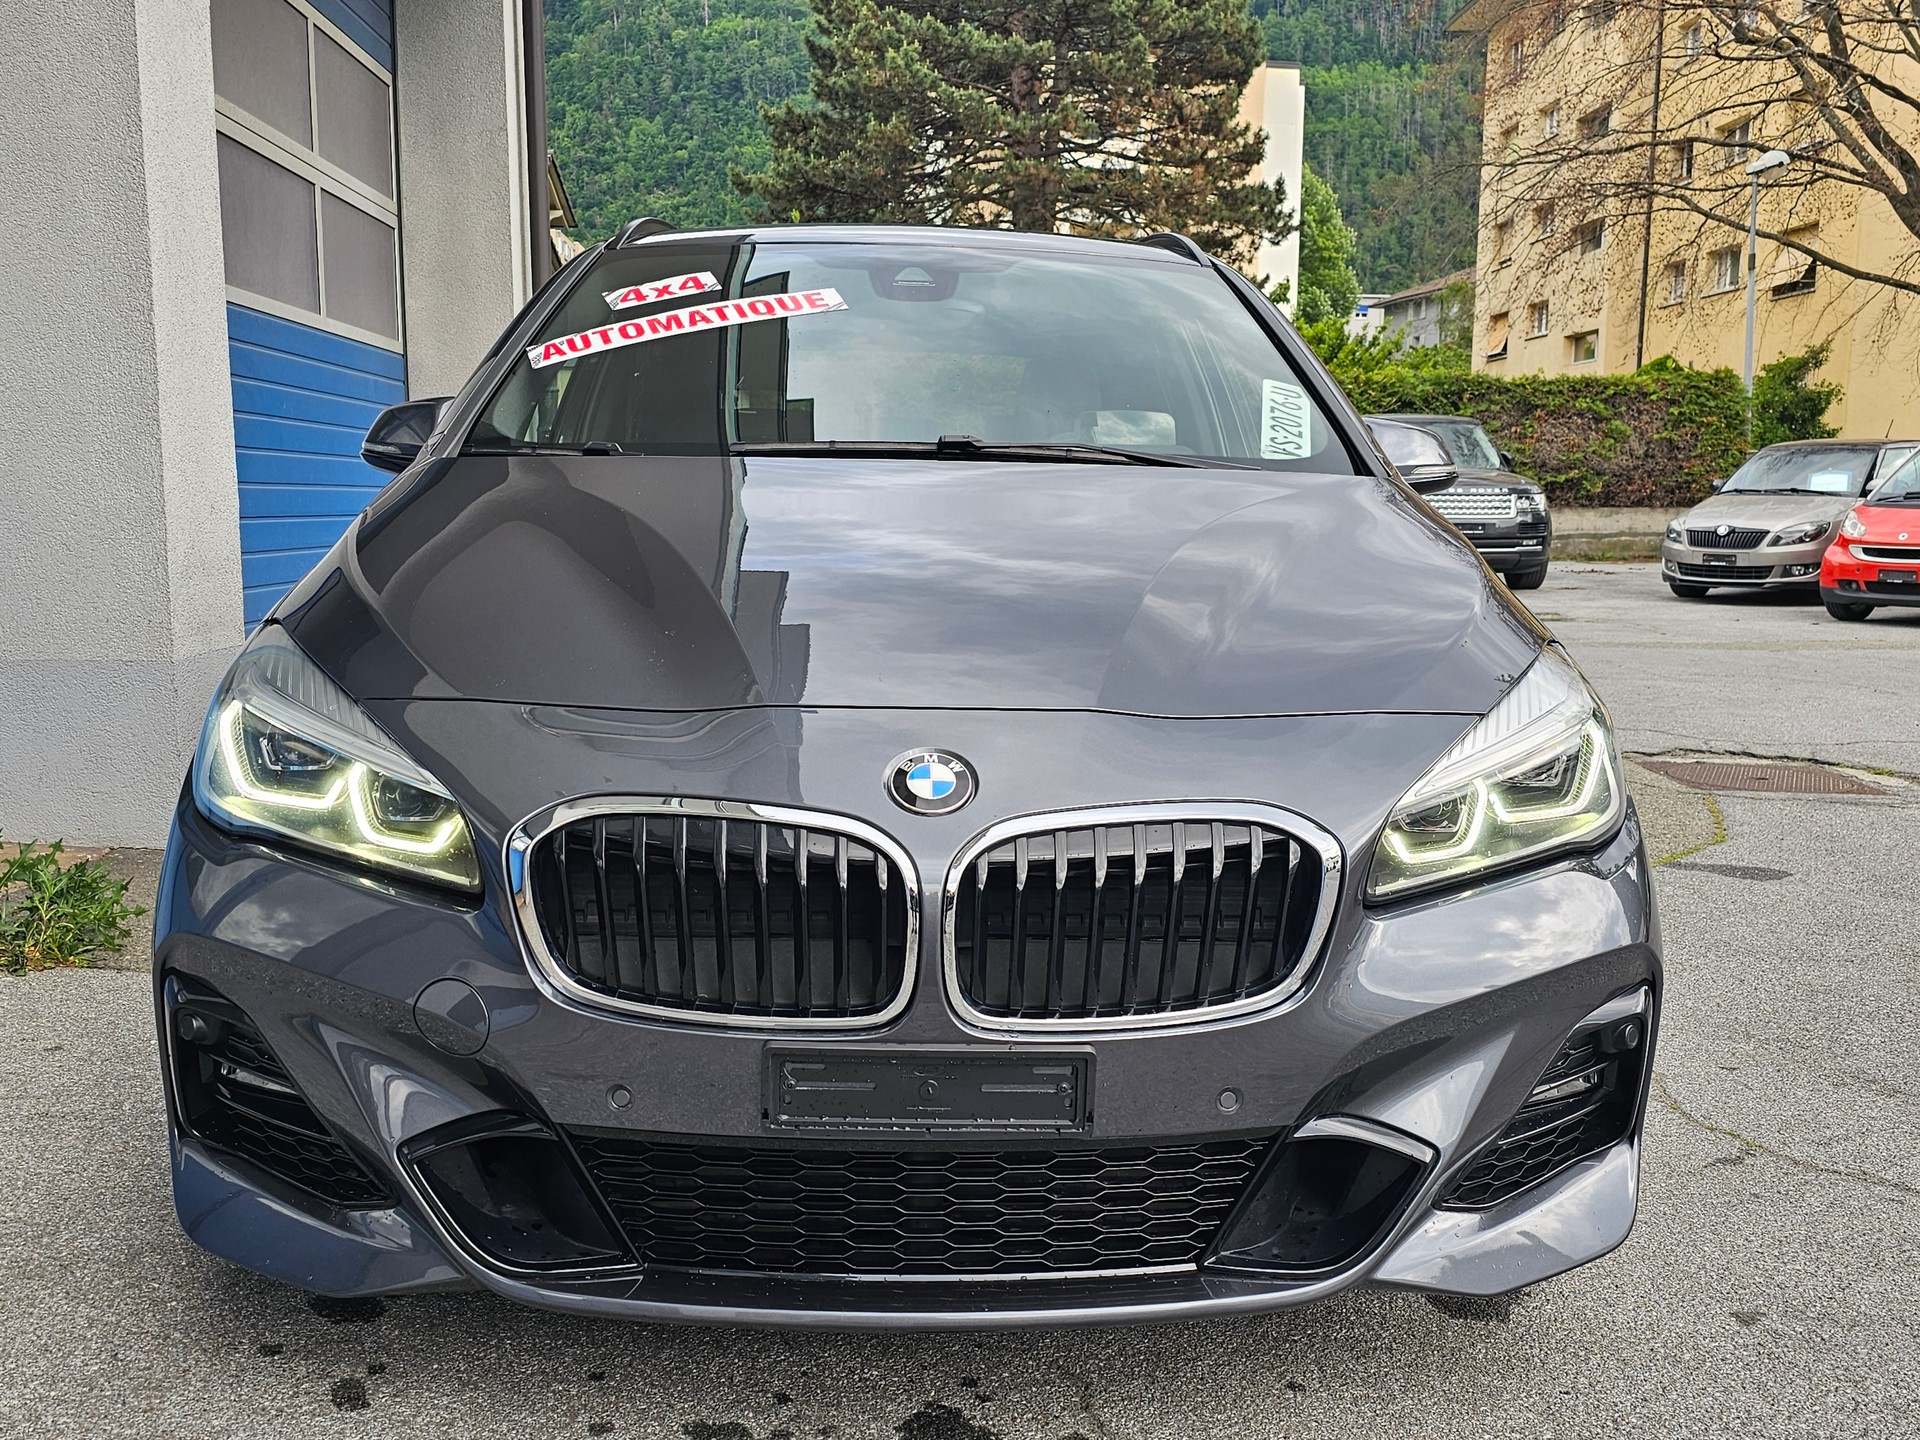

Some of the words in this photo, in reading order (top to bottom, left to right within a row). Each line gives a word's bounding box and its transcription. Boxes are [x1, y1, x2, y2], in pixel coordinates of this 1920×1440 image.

[620, 276, 707, 303] 4x4
[542, 292, 830, 362] AUTOMATIQUE
[900, 754, 965, 773] BMW
